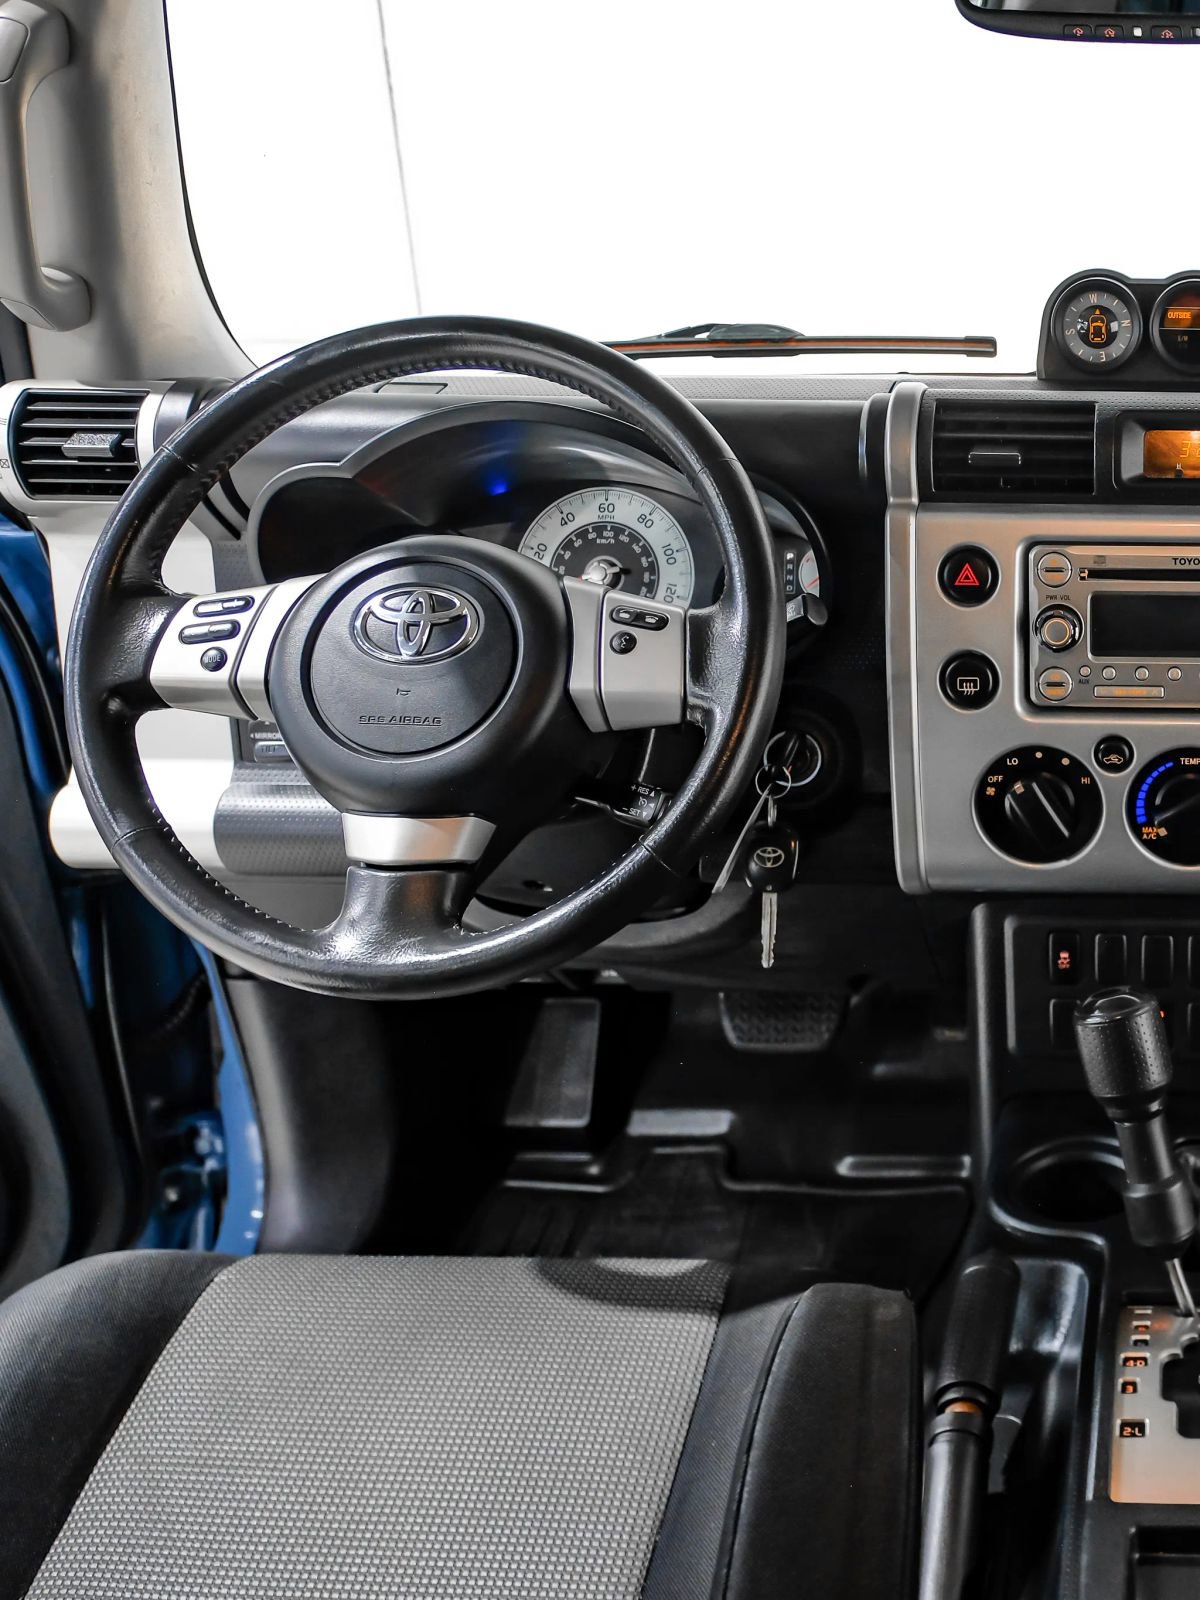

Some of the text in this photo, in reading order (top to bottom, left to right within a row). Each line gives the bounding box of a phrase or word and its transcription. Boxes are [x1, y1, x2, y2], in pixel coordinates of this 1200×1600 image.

[598, 503, 615, 513] 60
[560, 512, 576, 527] 40
[636, 513, 654, 529] 80
[534, 543, 548, 560] 20
[661, 543, 677, 565] 100
[786, 552, 794, 560] P
[663, 582, 678, 604] 120
[202, 654, 222, 664] MODE
[388, 715, 442, 725] AIRBAG
[1006, 757, 1019, 765] LO
[987, 775, 1003, 783] OFF
[1081, 777, 1091, 785] HI
[637, 786, 650, 795] RES
[628, 807, 641, 816] SET
